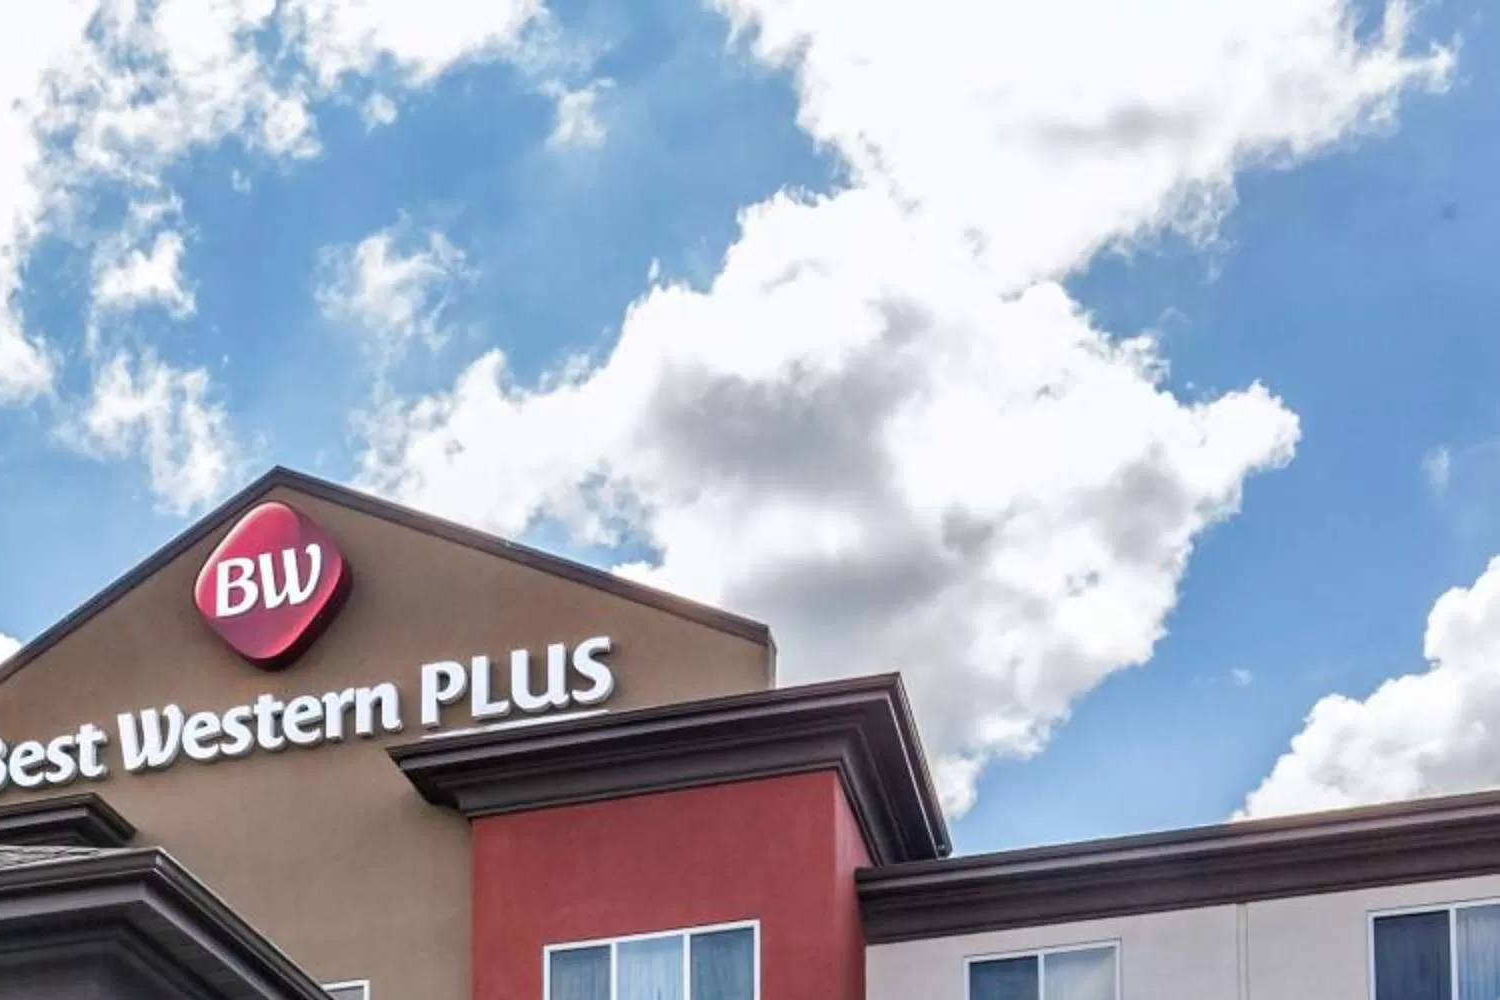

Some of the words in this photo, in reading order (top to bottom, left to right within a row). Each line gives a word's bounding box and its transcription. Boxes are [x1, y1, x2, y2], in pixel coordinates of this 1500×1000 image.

[214, 543, 321, 617] BW
[117, 682, 402, 773] Western
[421, 636, 614, 727] PLUS
